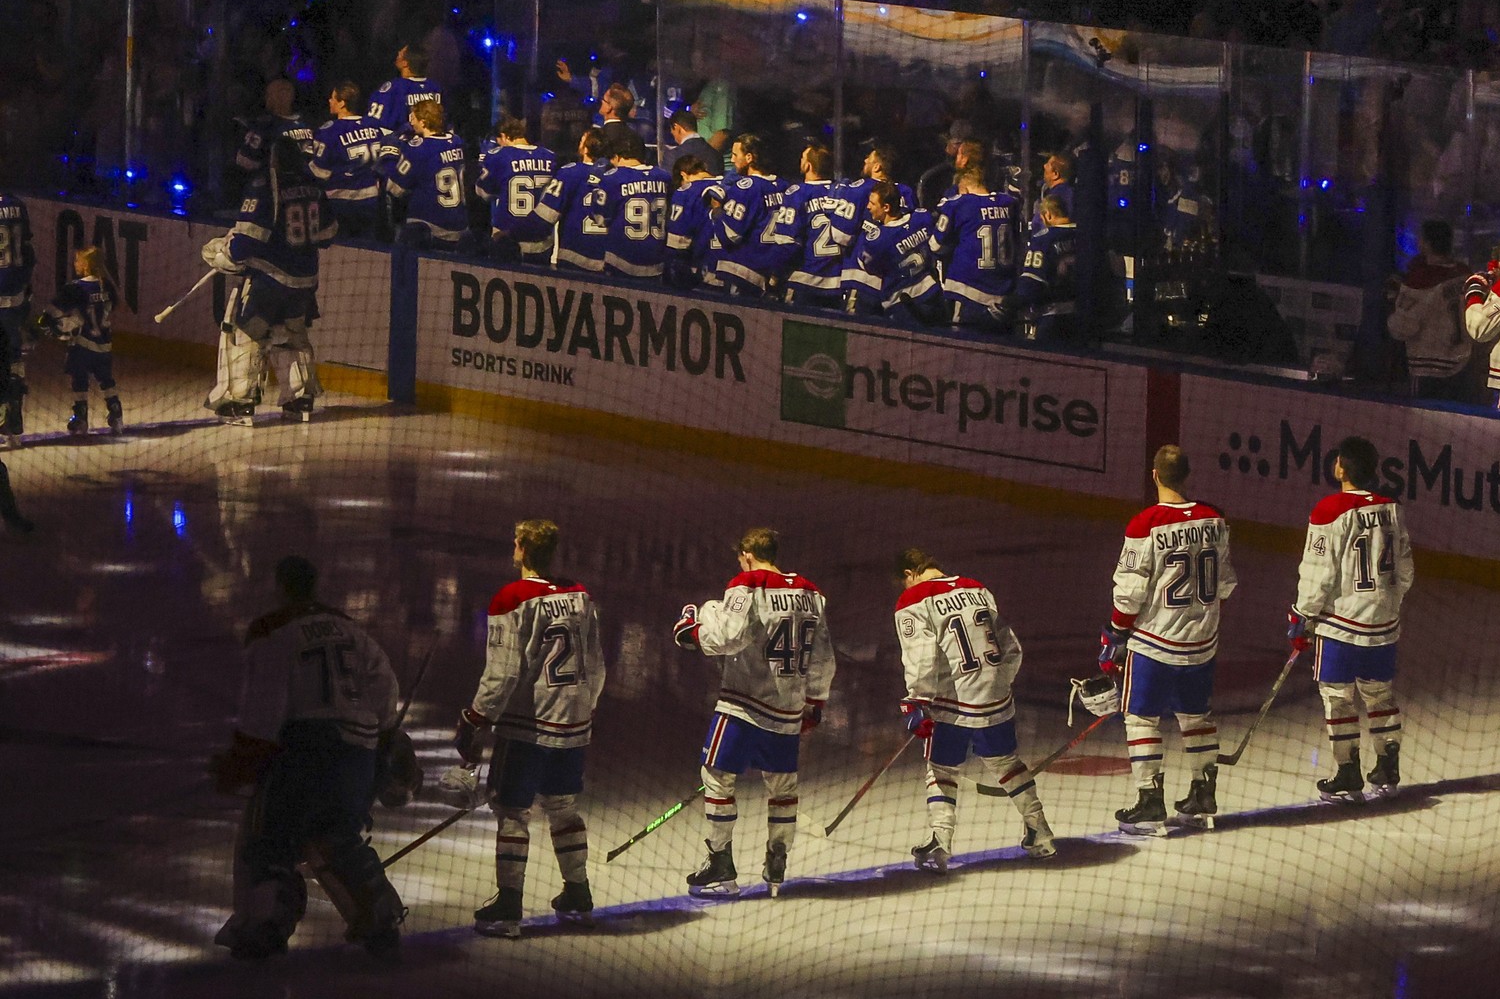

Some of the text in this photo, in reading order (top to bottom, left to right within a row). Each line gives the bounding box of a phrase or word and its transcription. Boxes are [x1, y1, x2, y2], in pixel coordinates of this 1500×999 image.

[368, 102, 384, 120] 31
[511, 160, 552, 173] CARLILE
[240, 198, 258, 213] 88
[723, 199, 747, 221] 46
[776, 206, 796, 225] 28
[834, 197, 856, 219] 20
[980, 206, 1011, 221] PERRY
[624, 198, 668, 240] 93
[811, 213, 841, 257] 2
[895, 227, 930, 255] GOURDE
[1023, 250, 1044, 268] 86
[450, 270, 746, 382] BODYARMOR
[451, 347, 575, 386] SPORTS DRINK
[784, 353, 1100, 437] enterprise
[1353, 532, 1396, 593] 14
[1163, 546, 1219, 608] 20
[543, 596, 577, 620] GUHLE
[770, 594, 816, 612] HUTSON
[935, 592, 988, 616] CAUFIELD
[765, 617, 818, 678] 48
[948, 608, 1003, 674] 13
